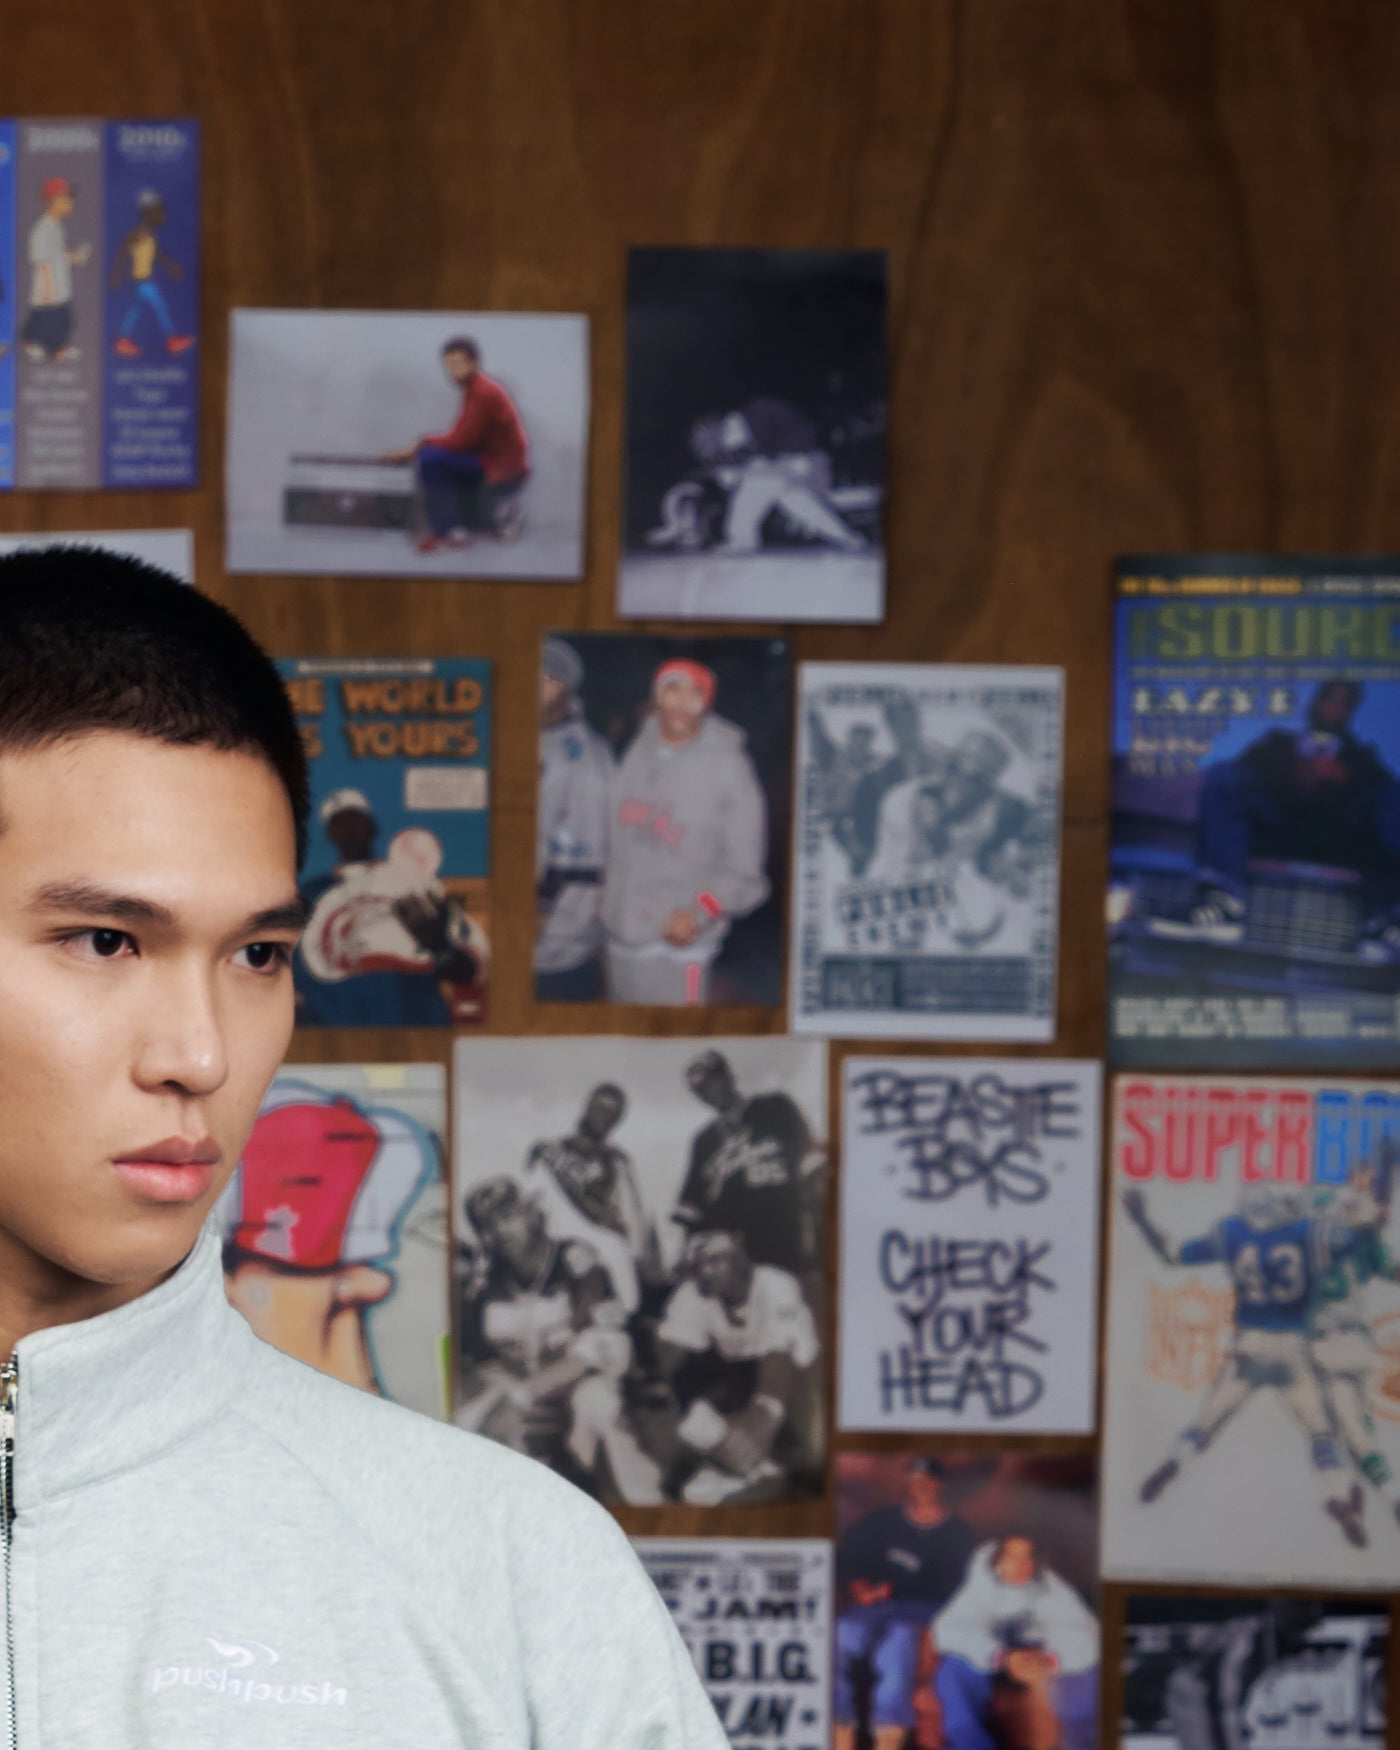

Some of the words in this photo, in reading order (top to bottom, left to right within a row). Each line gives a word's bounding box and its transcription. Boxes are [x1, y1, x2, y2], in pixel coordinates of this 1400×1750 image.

[341, 678, 483, 715] WORLD
[345, 720, 481, 759] YOURS
[850, 1069, 1082, 1139] BEASTIE
[897, 1132, 1050, 1206] BOYS
[879, 1229, 1057, 1306] CHECK
[896, 1297, 1049, 1358] YOUR
[878, 1347, 1046, 1418] HEAD
[149, 1664, 349, 1705] pushpush
